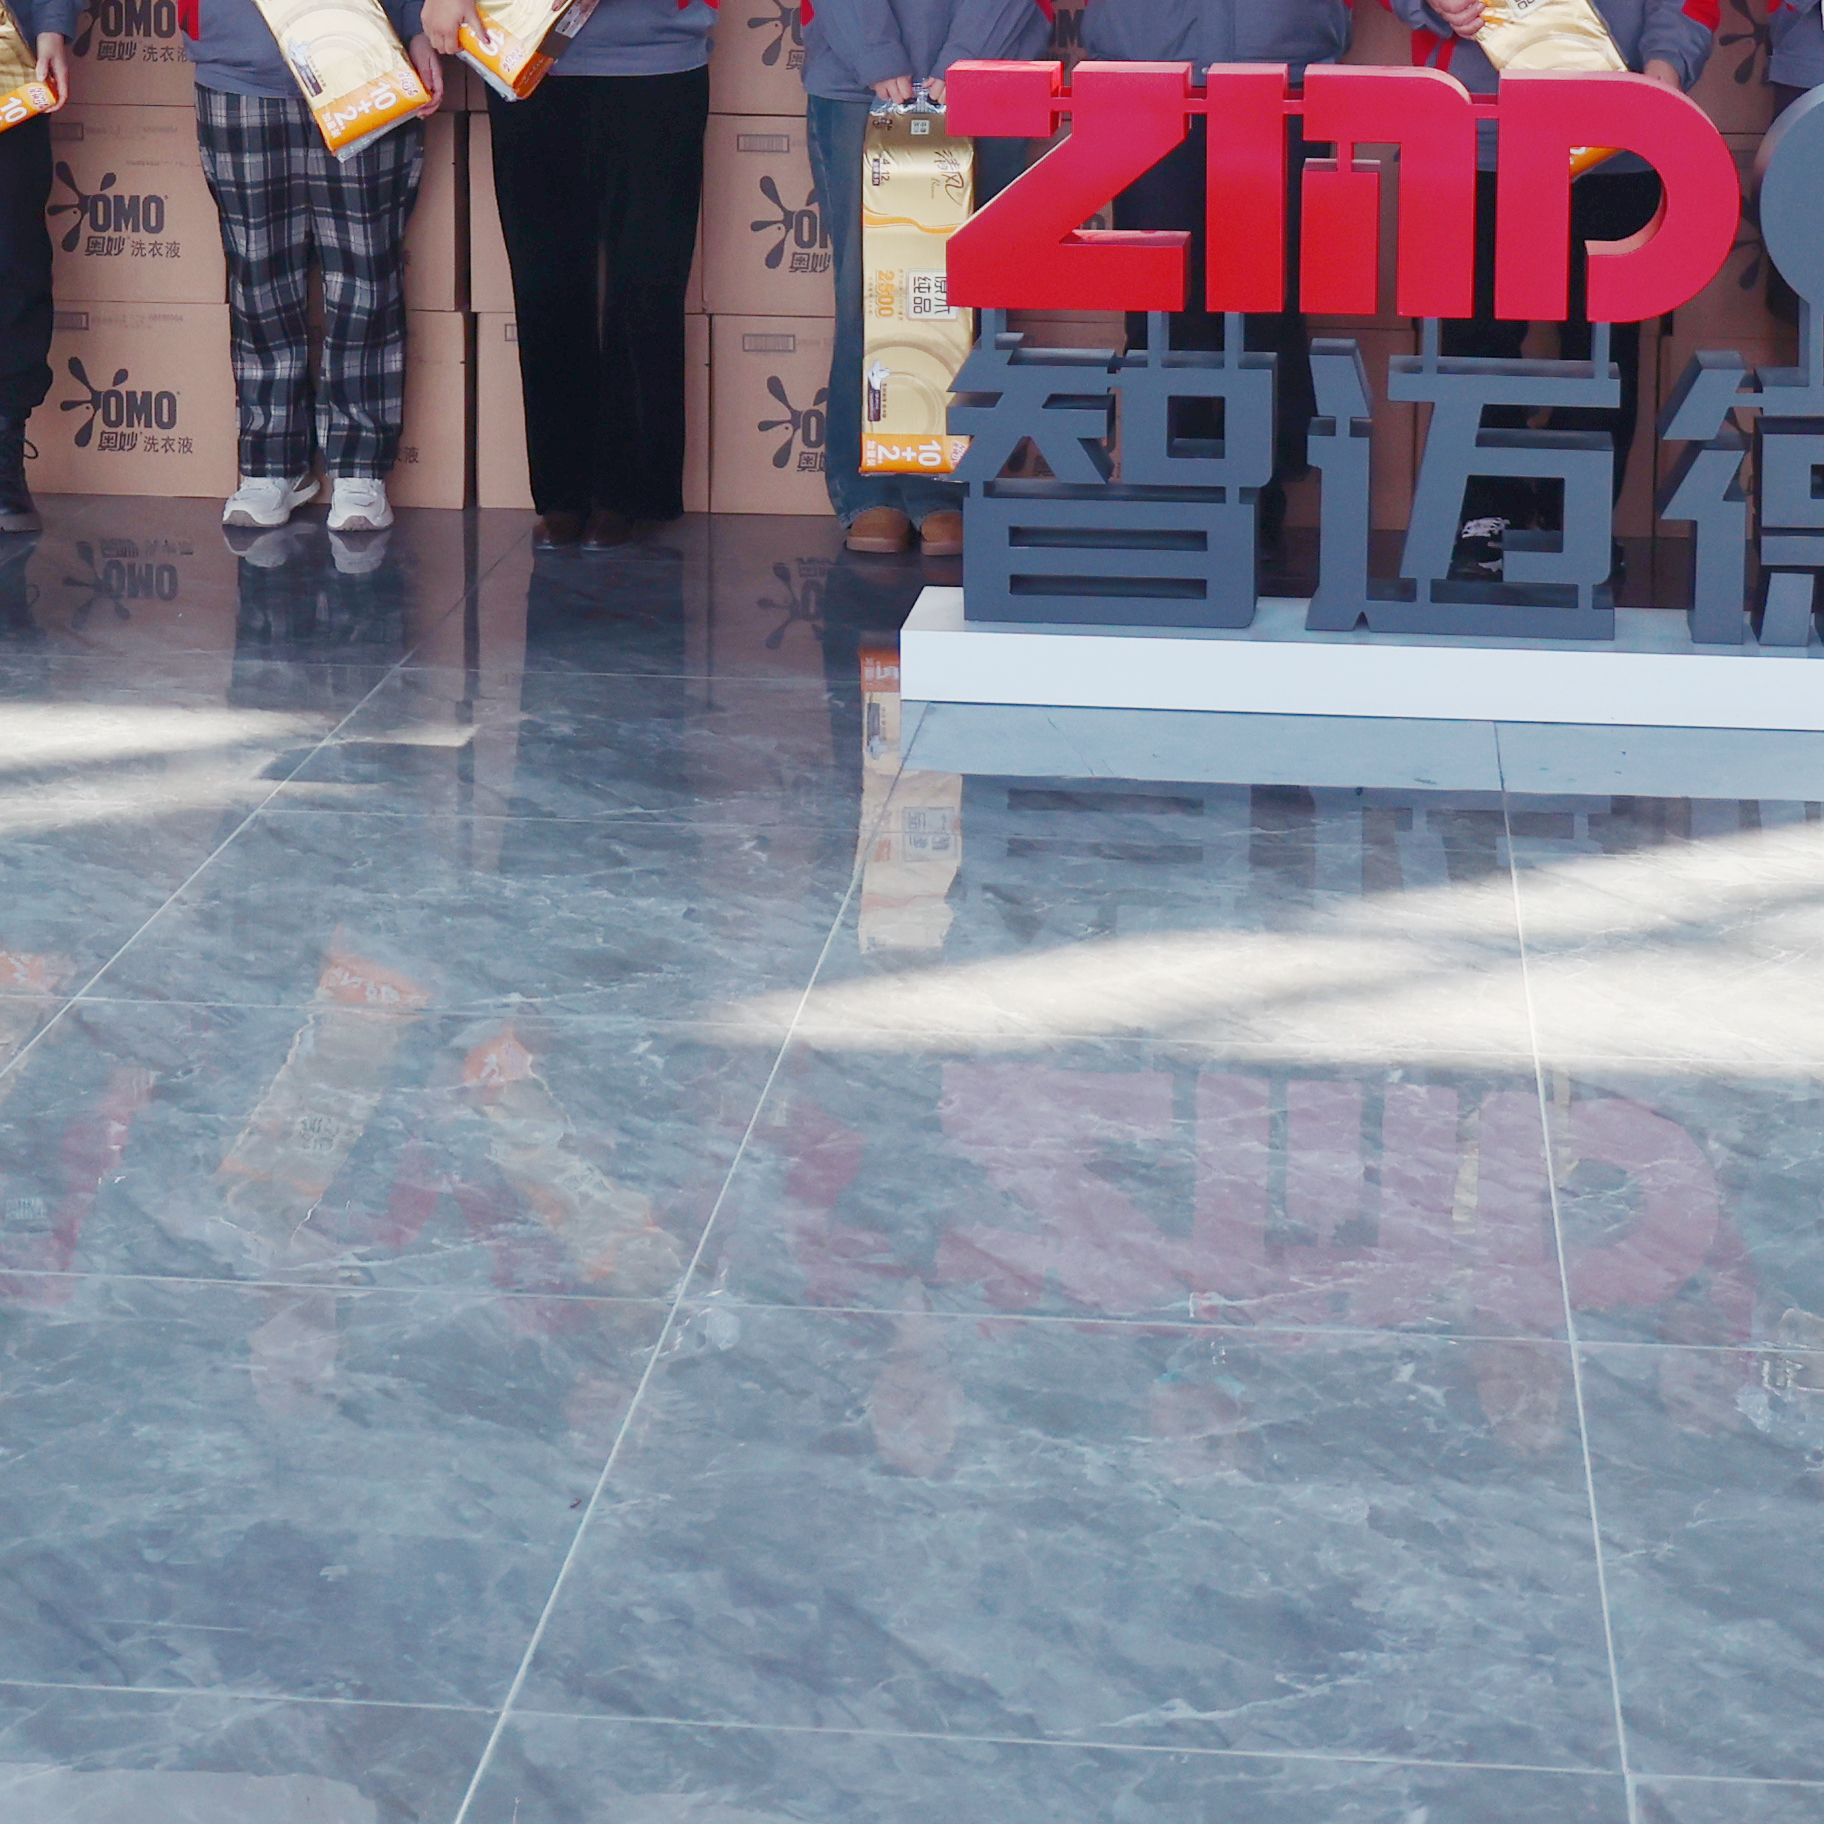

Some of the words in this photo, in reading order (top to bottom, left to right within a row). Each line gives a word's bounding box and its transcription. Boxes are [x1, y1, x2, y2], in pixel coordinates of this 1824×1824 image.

[97, 40, 137, 62] 奥妙
[89, 193, 165, 233] OMO
[85, 236, 125, 257] 奥妙
[130, 239, 181, 259] 洗衣液
[913, 276, 932, 314] 纯品
[101, 388, 178, 429] OMO
[98, 431, 138, 453] 奥妙
[143, 434, 194, 454] 洗衣液
